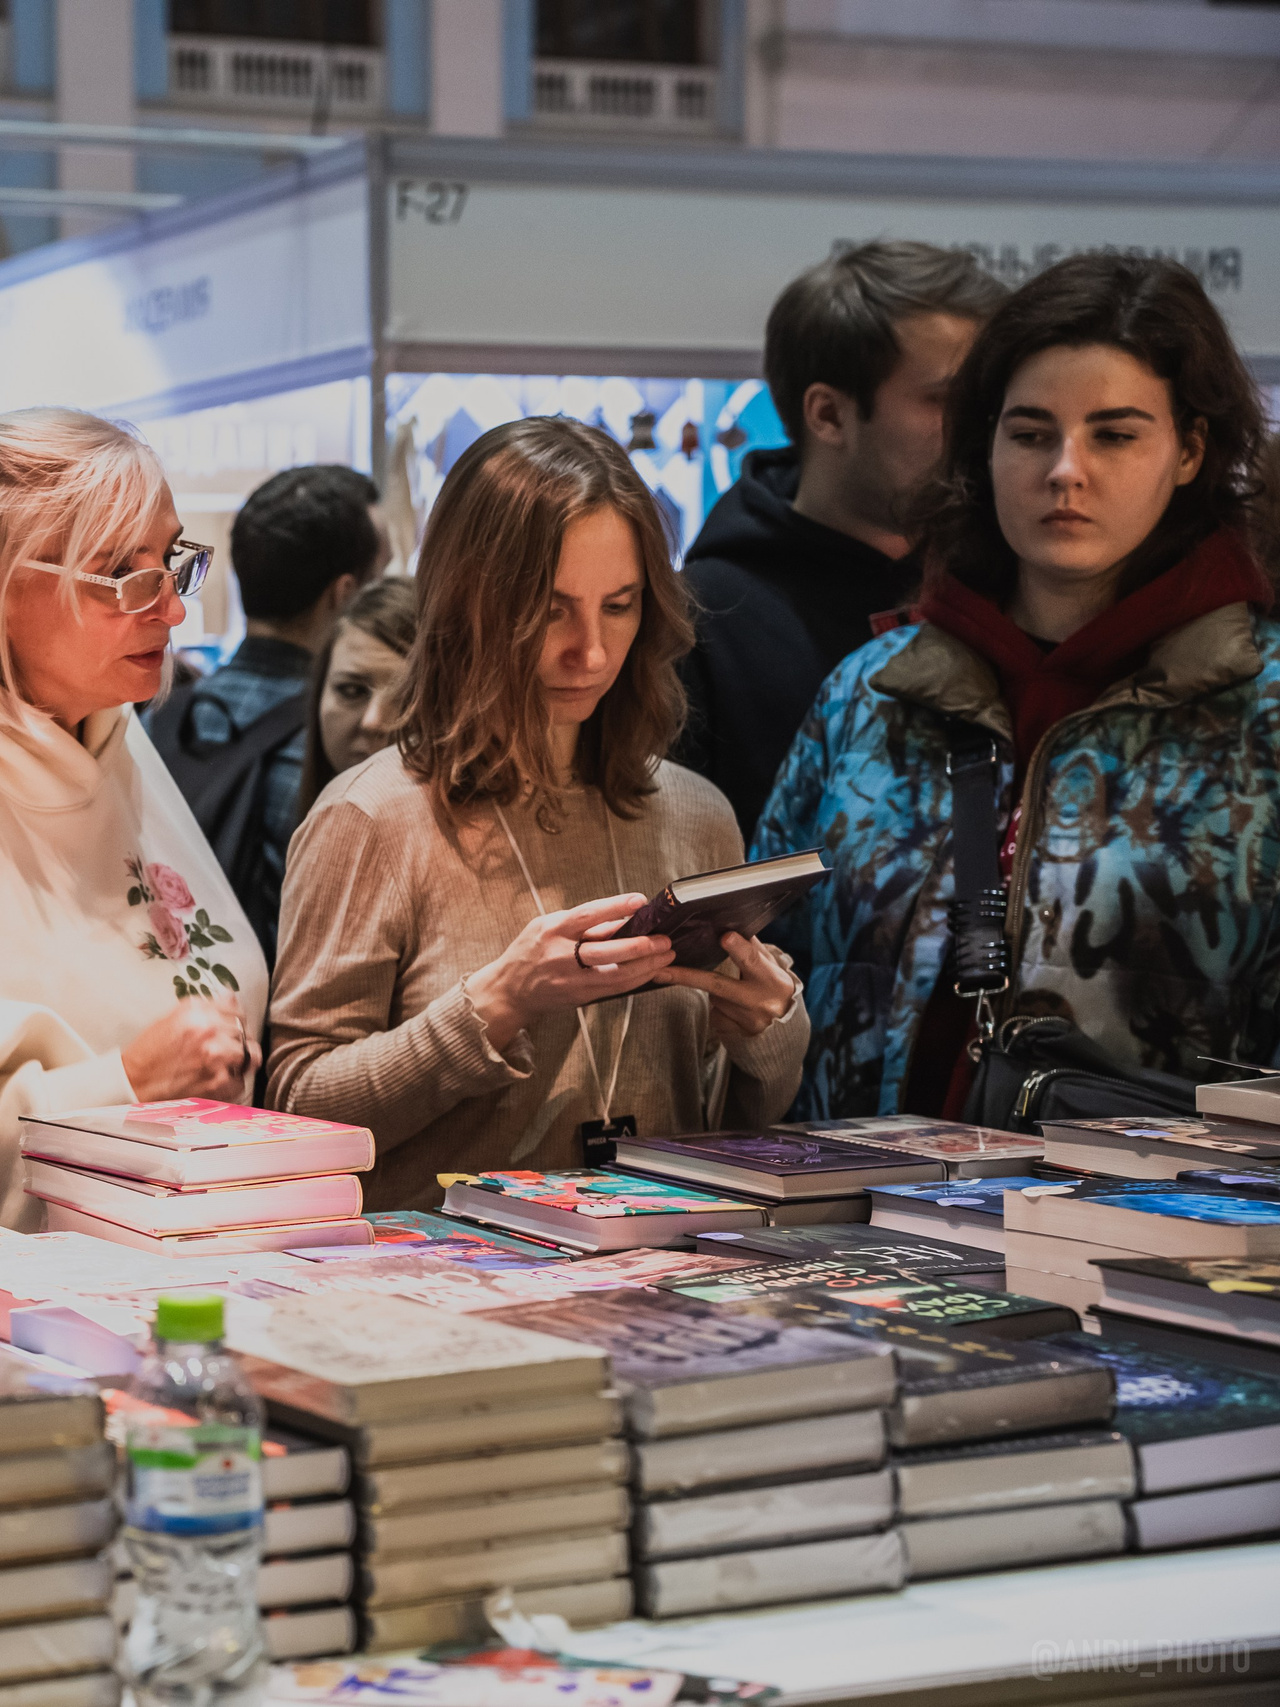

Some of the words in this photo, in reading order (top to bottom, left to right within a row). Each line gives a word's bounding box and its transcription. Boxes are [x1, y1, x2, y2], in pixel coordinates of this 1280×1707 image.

[396, 179, 470, 225] F-27
[716, 1266, 867, 1297] СКРЫВАЕТ
[826, 1272, 899, 1288] ЧТО
[914, 1299, 1010, 1318] САРА
